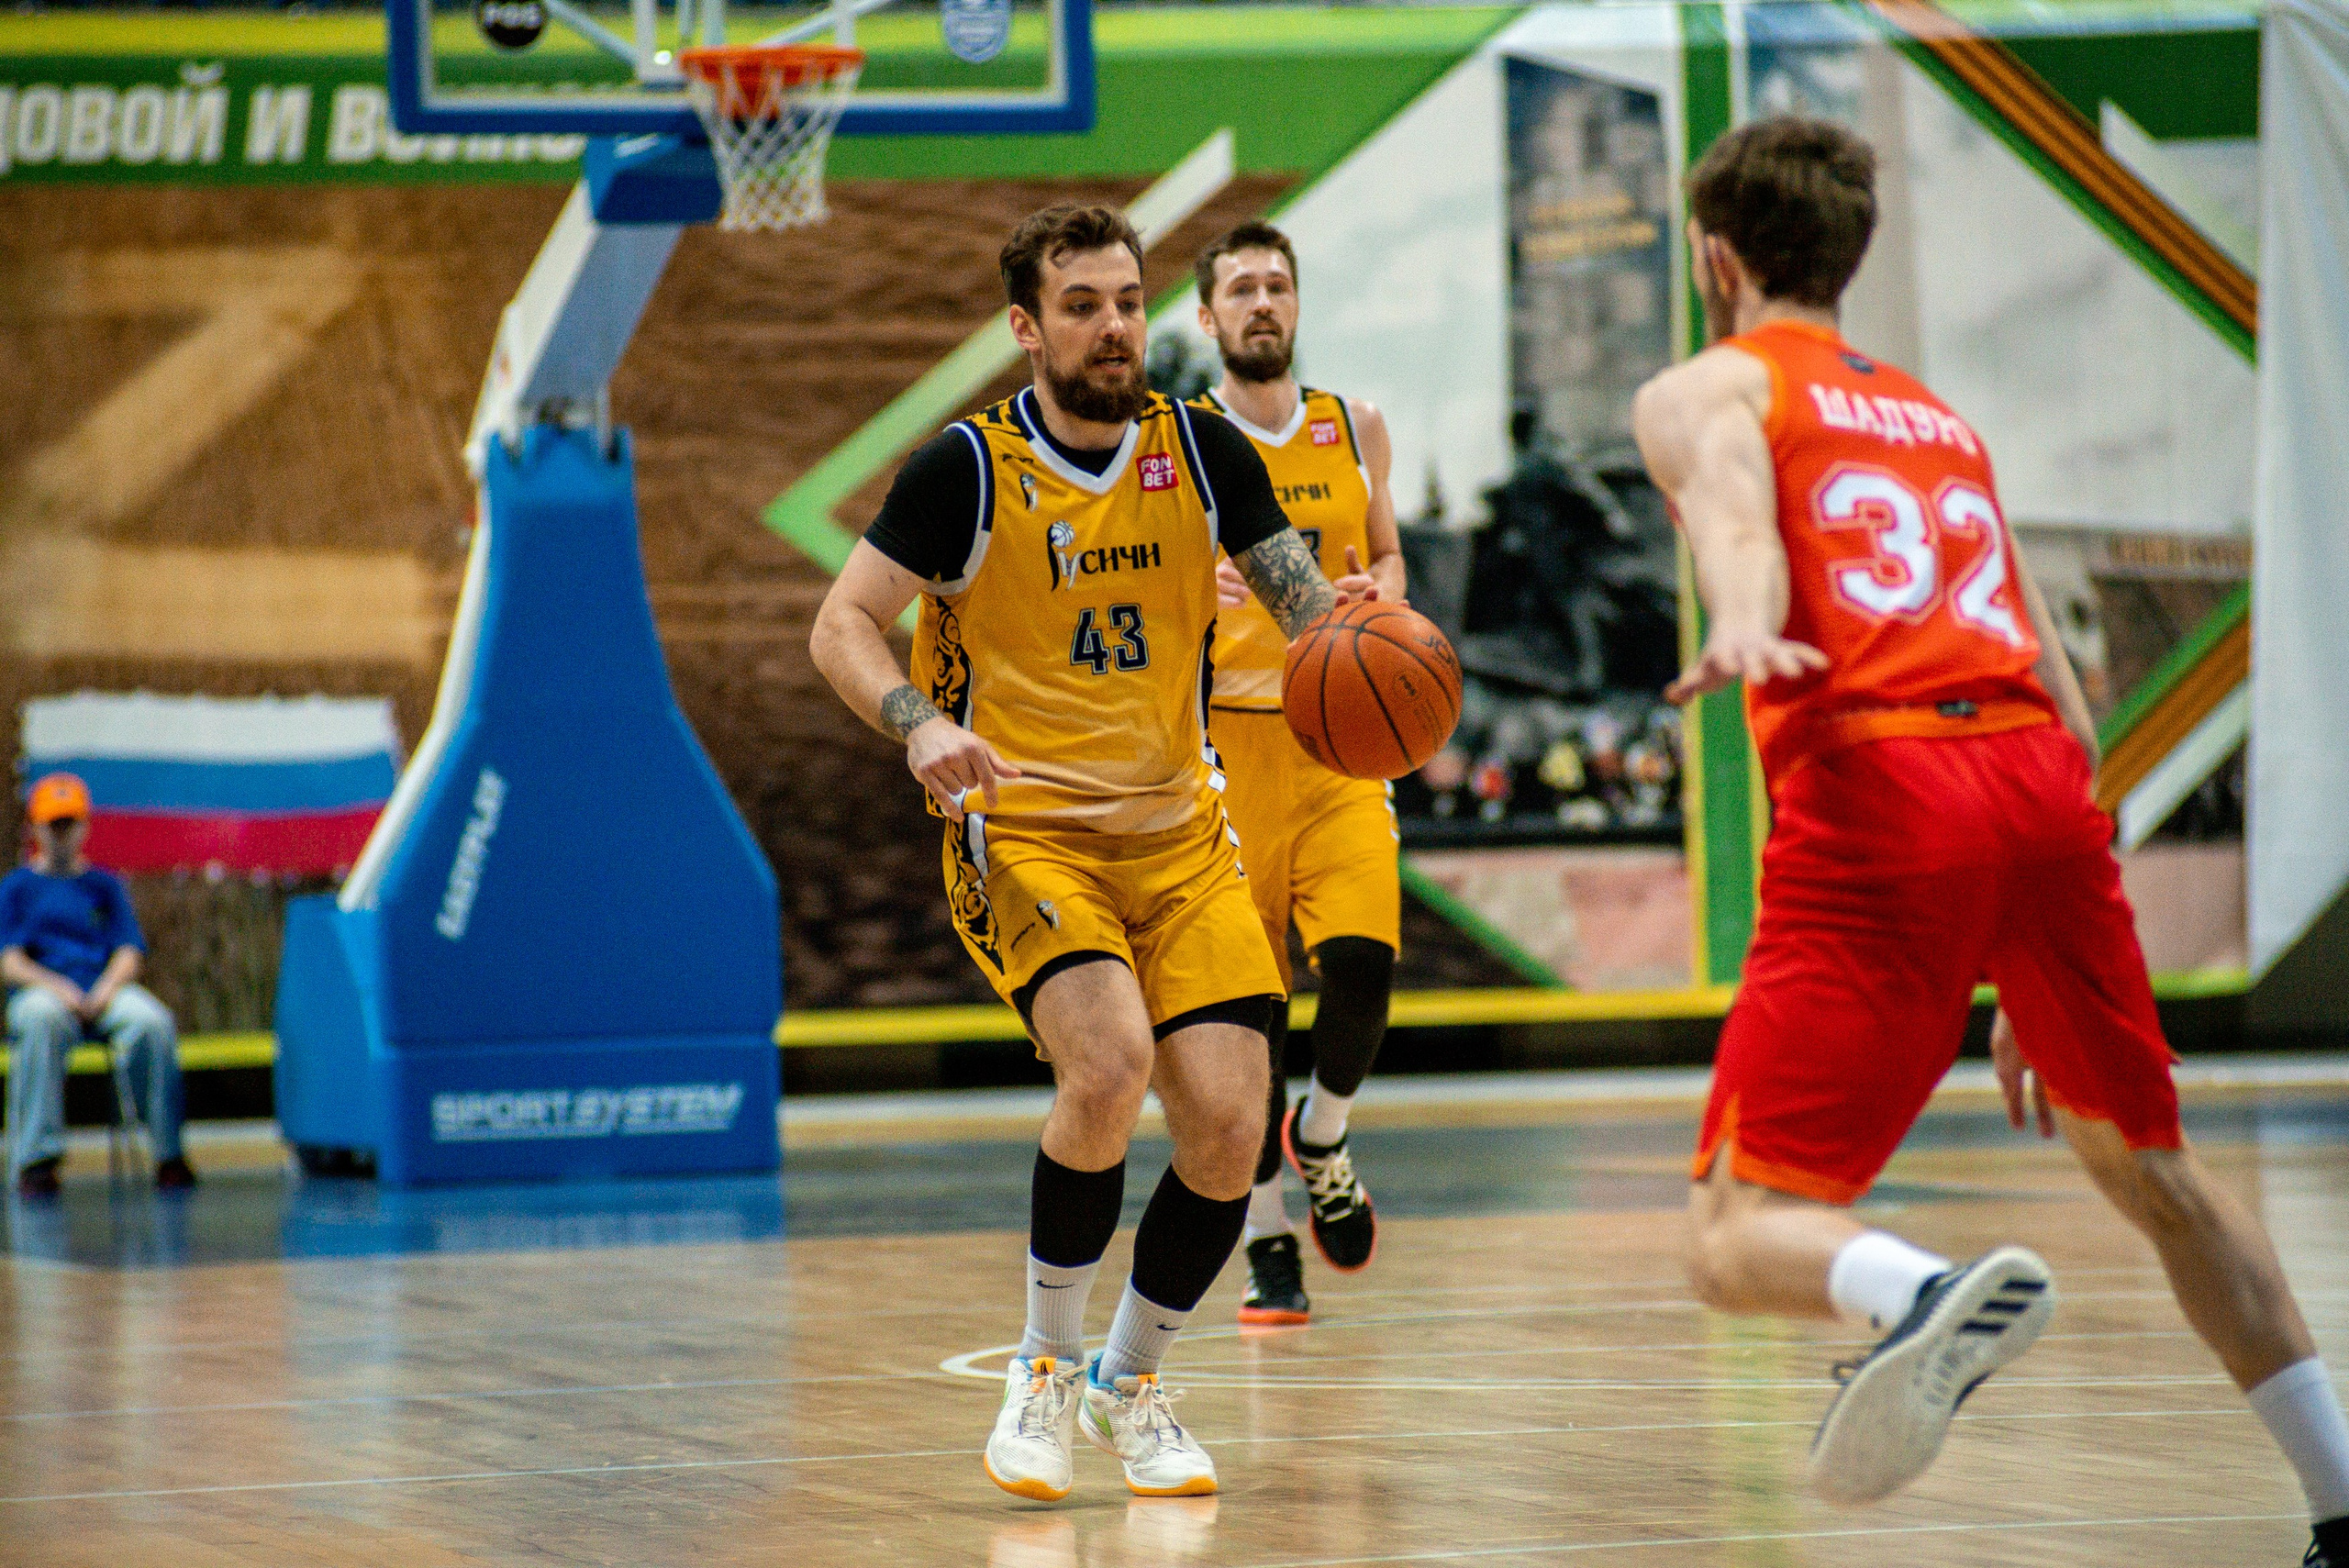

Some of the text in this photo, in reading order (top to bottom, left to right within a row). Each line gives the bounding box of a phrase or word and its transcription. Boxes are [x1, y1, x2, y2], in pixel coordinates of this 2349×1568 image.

[0, 61, 229, 174] ОВОЙ
[244, 84, 314, 164] И
[1141, 455, 1172, 473] FON
[1143, 469, 1174, 487] BET
[1810, 462, 2041, 655] 32
[1070, 603, 1150, 675] 43
